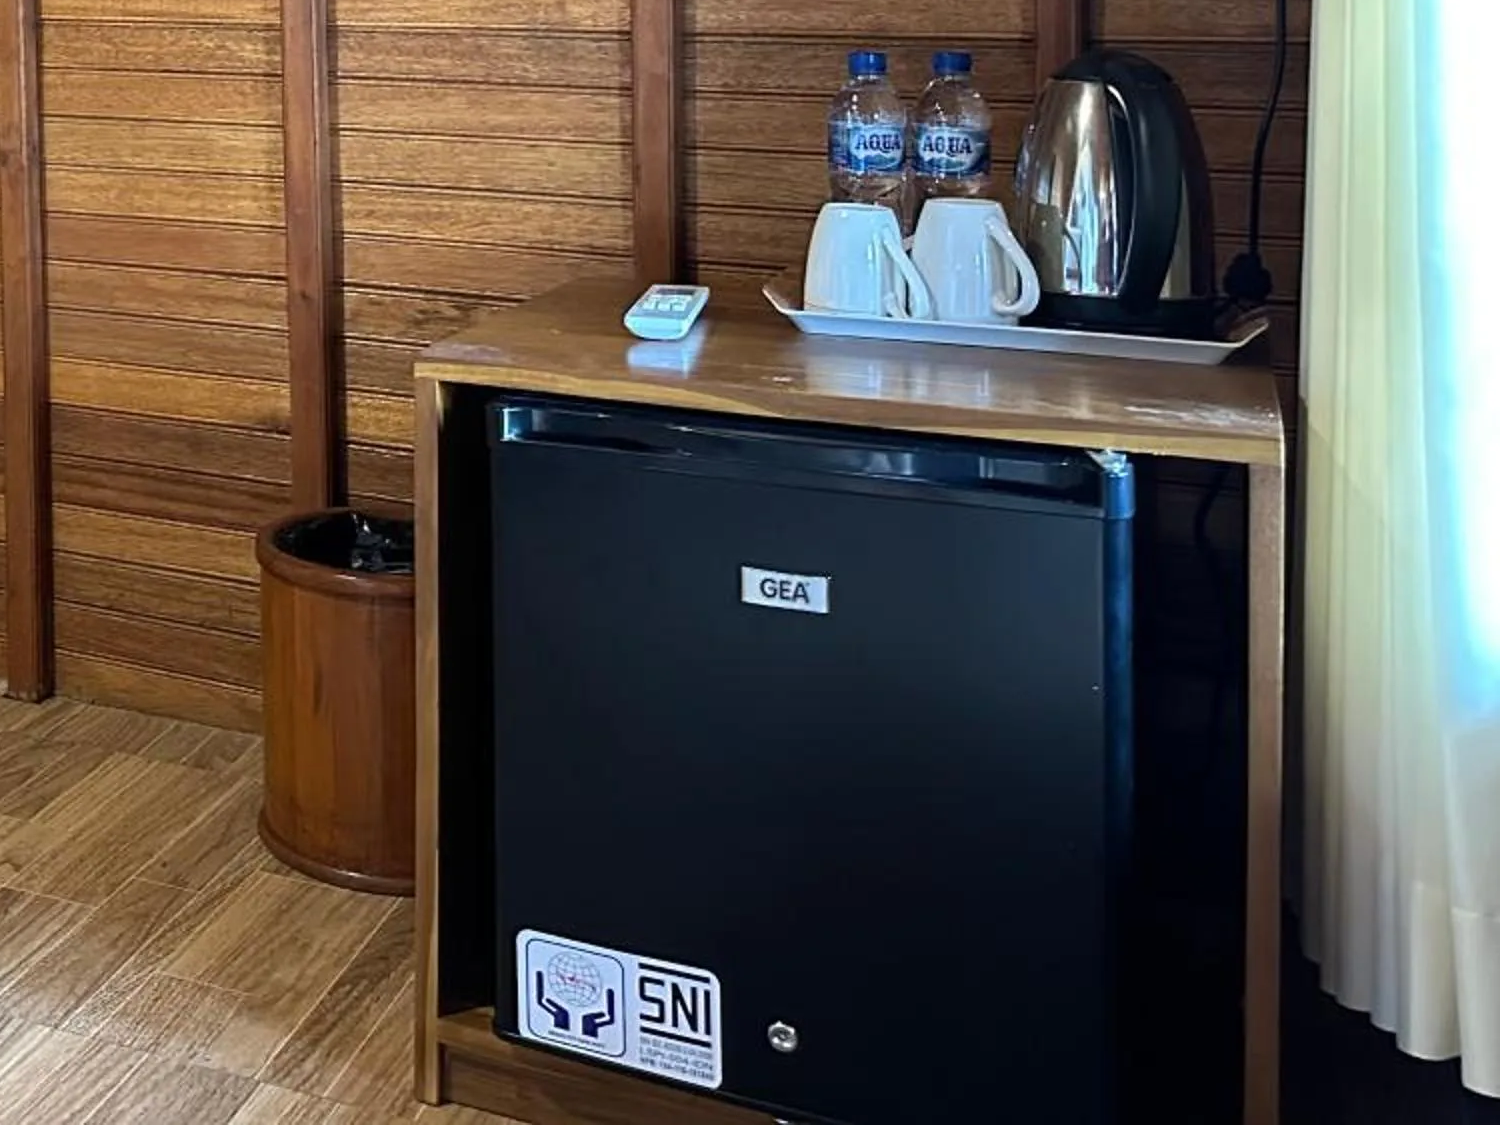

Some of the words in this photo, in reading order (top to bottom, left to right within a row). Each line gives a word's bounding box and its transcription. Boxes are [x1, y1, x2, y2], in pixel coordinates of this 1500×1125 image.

[855, 134, 901, 154] AQUA
[923, 135, 973, 156] AQUA
[760, 578, 810, 604] GEA
[639, 976, 711, 1036] SNI
